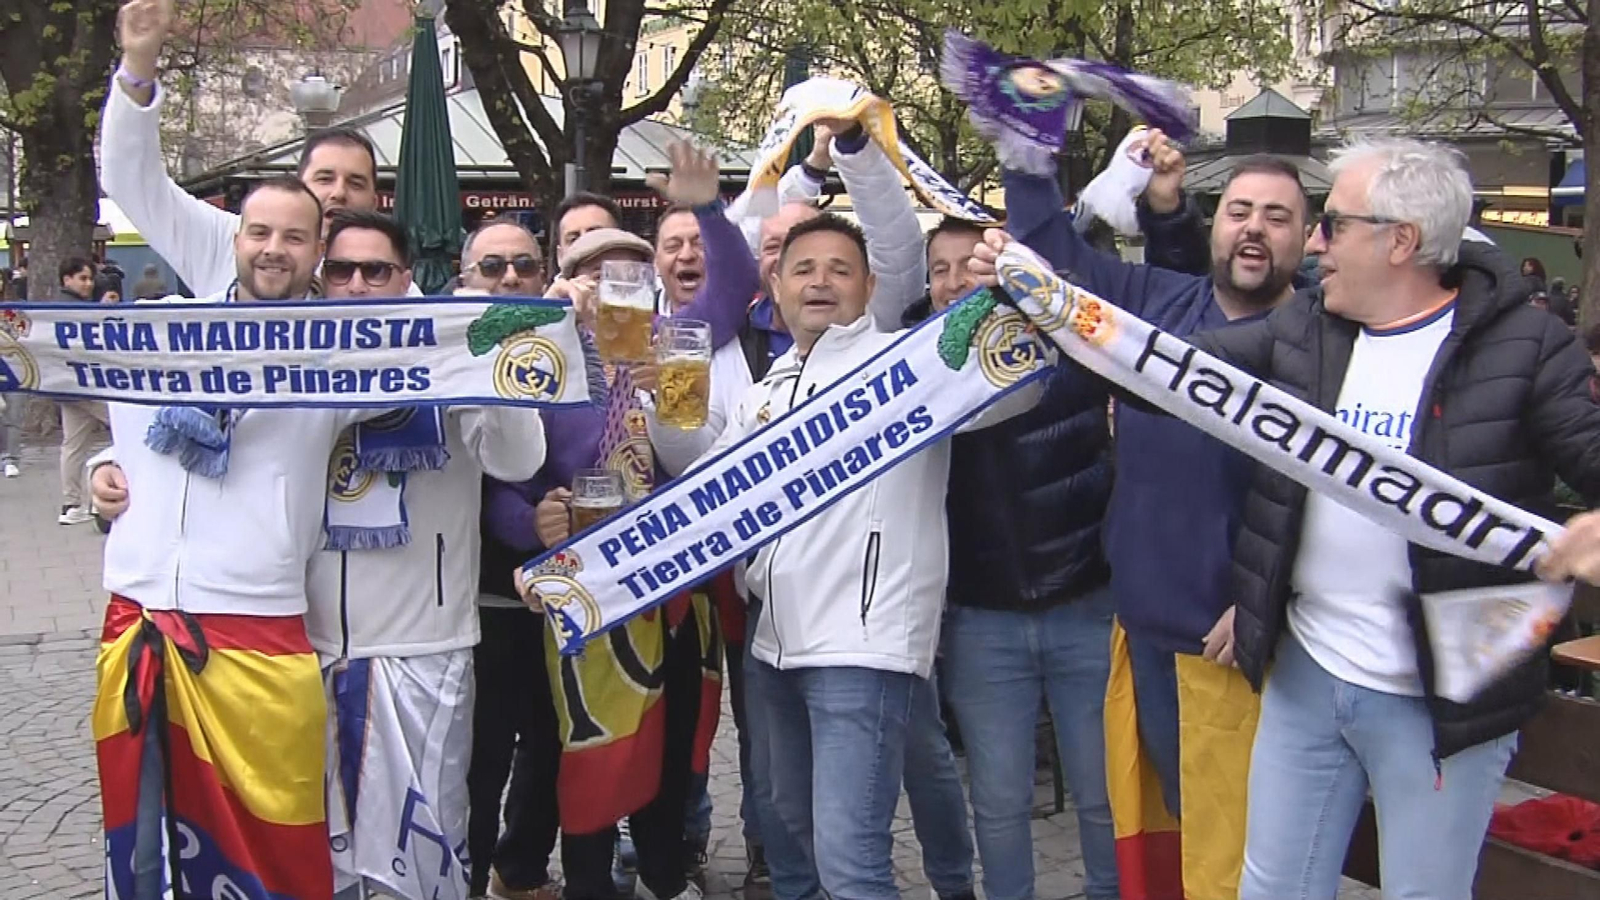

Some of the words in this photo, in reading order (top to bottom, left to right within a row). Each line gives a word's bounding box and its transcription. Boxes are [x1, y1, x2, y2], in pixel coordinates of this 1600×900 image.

[465, 195, 536, 208] Geträn
[55, 316, 159, 351] PEÑA
[168, 318, 438, 352] MADRIDISTA
[66, 361, 192, 393] Tierra
[200, 366, 252, 394] de
[263, 365, 431, 394] Pinares
[598, 509, 692, 568] PEÑA
[688, 358, 919, 517] MADRIDISTA
[617, 530, 734, 600] Tierra
[733, 501, 783, 541] de
[782, 404, 934, 511] Pinares
[1134, 329, 1545, 568] Halamadri
